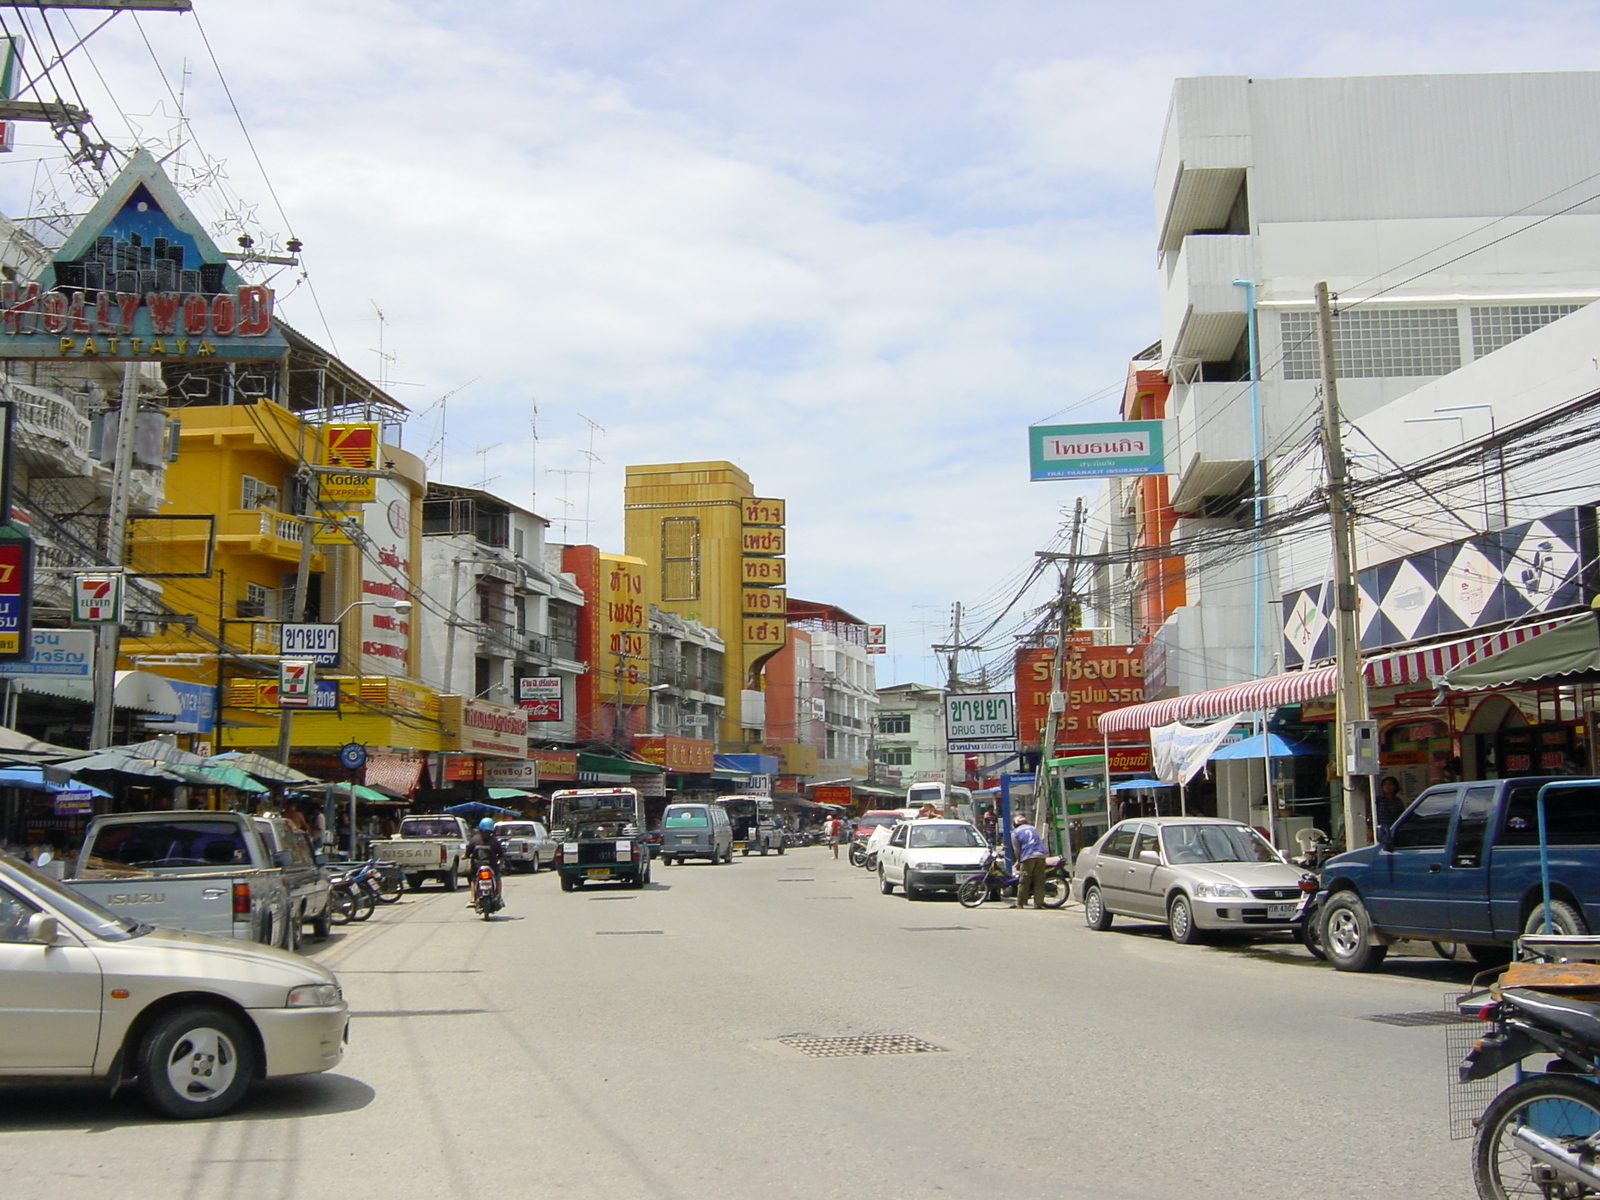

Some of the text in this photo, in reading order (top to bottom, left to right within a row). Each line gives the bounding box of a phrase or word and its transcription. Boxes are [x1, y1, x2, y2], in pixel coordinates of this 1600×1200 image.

[0, 281, 274, 337] HOLLYWOOD
[59, 337, 216, 356] PATTAYA
[1051, 438, 1144, 456] ไทยธนกิจ
[326, 474, 369, 486] Kodak
[746, 500, 780, 522] ห้าง
[744, 532, 781, 550] เพชร
[610, 563, 641, 595] ห้าง
[745, 563, 781, 578] ทอง
[746, 593, 781, 609] ทอง
[608, 599, 643, 625] เพชร
[285, 628, 336, 650] ขายยา
[950, 699, 1008, 722] ขายยา
[951, 723, 1008, 736] DRUG STORE
[524, 767, 533, 776] 3
[1024, 829, 1035, 845] 2
[382, 849, 432, 858] NISSAN
[108, 893, 166, 906] ISUZU
